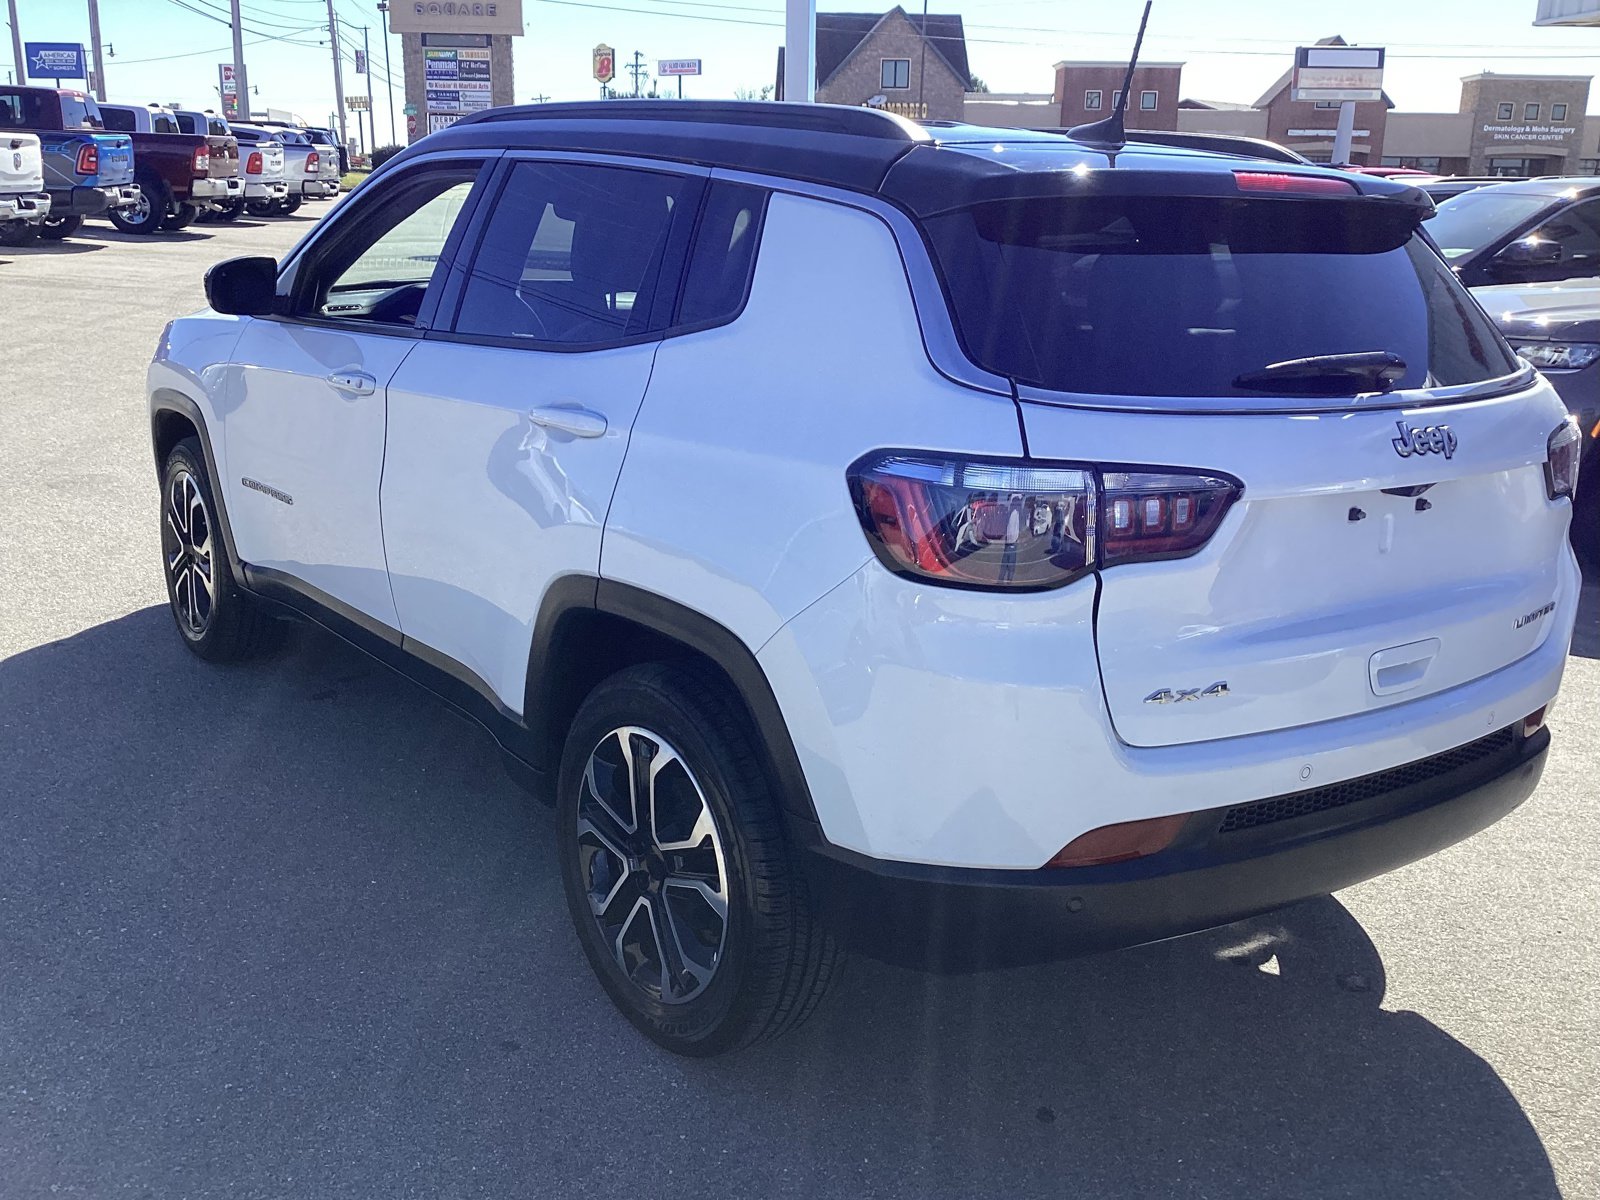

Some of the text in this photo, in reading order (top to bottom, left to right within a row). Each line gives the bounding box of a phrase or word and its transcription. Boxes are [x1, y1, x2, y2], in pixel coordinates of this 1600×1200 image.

[415, 3, 498, 16] SQUARE
[1483, 124, 1524, 133] Dermatology
[1550, 126, 1576, 134] Surgery
[1392, 420, 1458, 460] Jeep
[1143, 680, 1230, 704] 4x4
